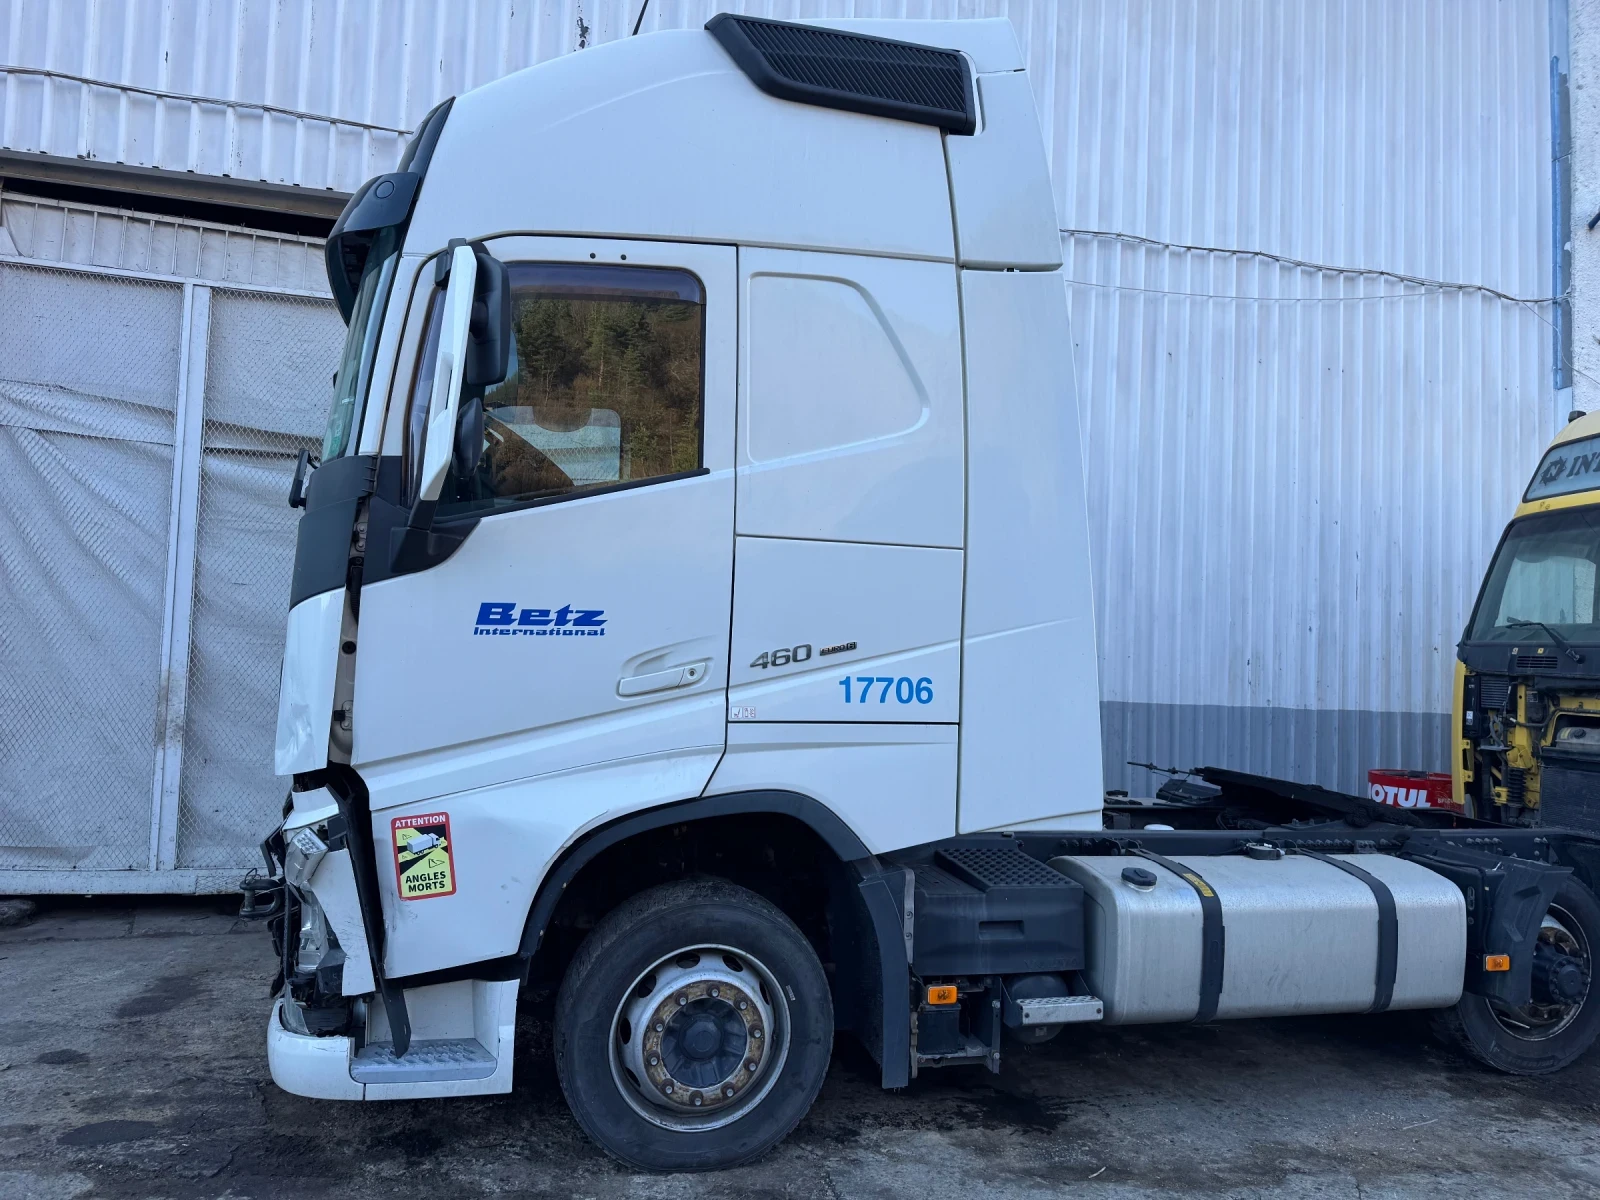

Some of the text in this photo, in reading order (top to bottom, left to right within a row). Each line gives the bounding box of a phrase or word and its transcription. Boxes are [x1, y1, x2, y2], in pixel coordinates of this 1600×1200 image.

[475, 602, 608, 626] Betz
[473, 627, 606, 636] International
[749, 643, 812, 669] 460
[839, 676, 934, 704] 17706
[1369, 782, 1431, 808] OTUL
[395, 814, 446, 828] ATTENTION
[405, 870, 446, 884] ANGLES
[408, 880, 446, 893] MORTS
